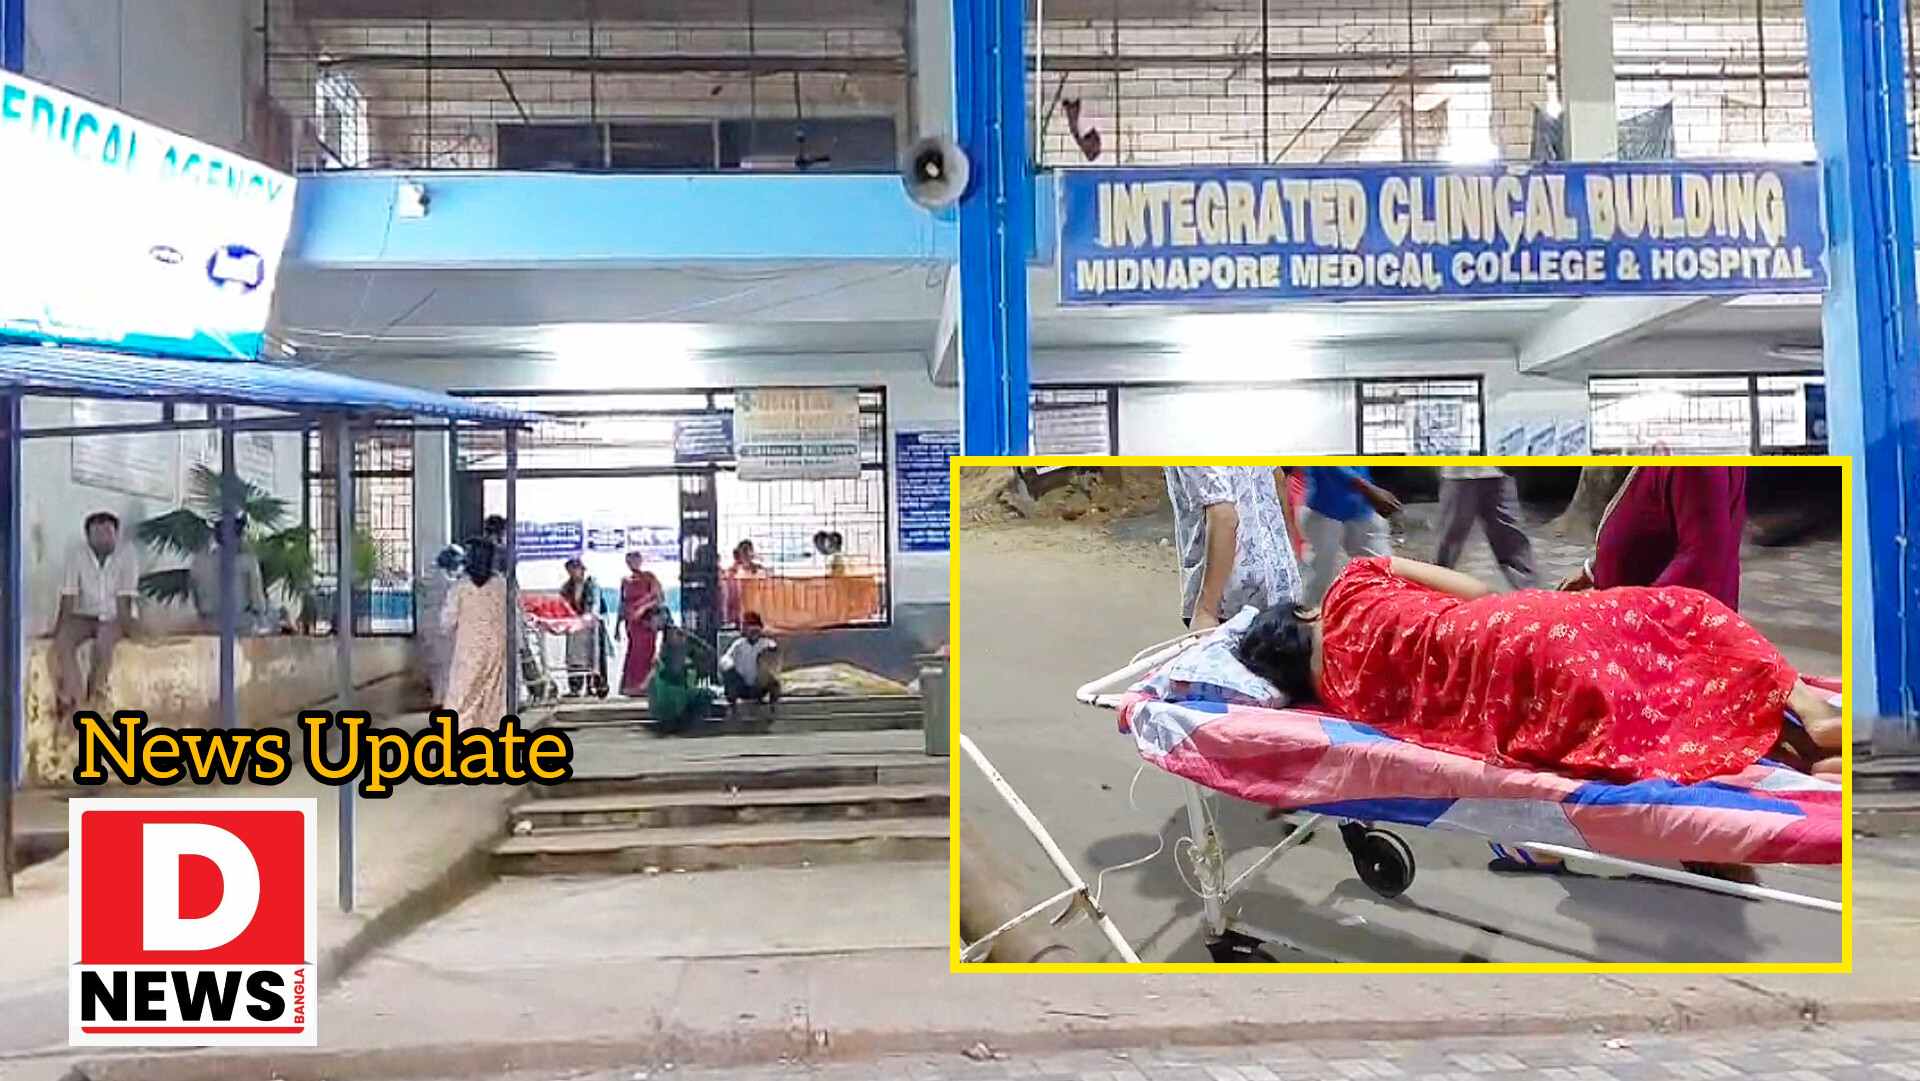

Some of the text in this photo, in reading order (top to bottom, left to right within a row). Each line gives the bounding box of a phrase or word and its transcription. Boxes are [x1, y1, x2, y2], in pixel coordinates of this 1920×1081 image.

[1096, 171, 1787, 251] INTEGRATED CLINICAL BUILDING
[1076, 245, 1814, 294] MIDNAPORE MEDICAL COLLEGE & HOSPITAL
